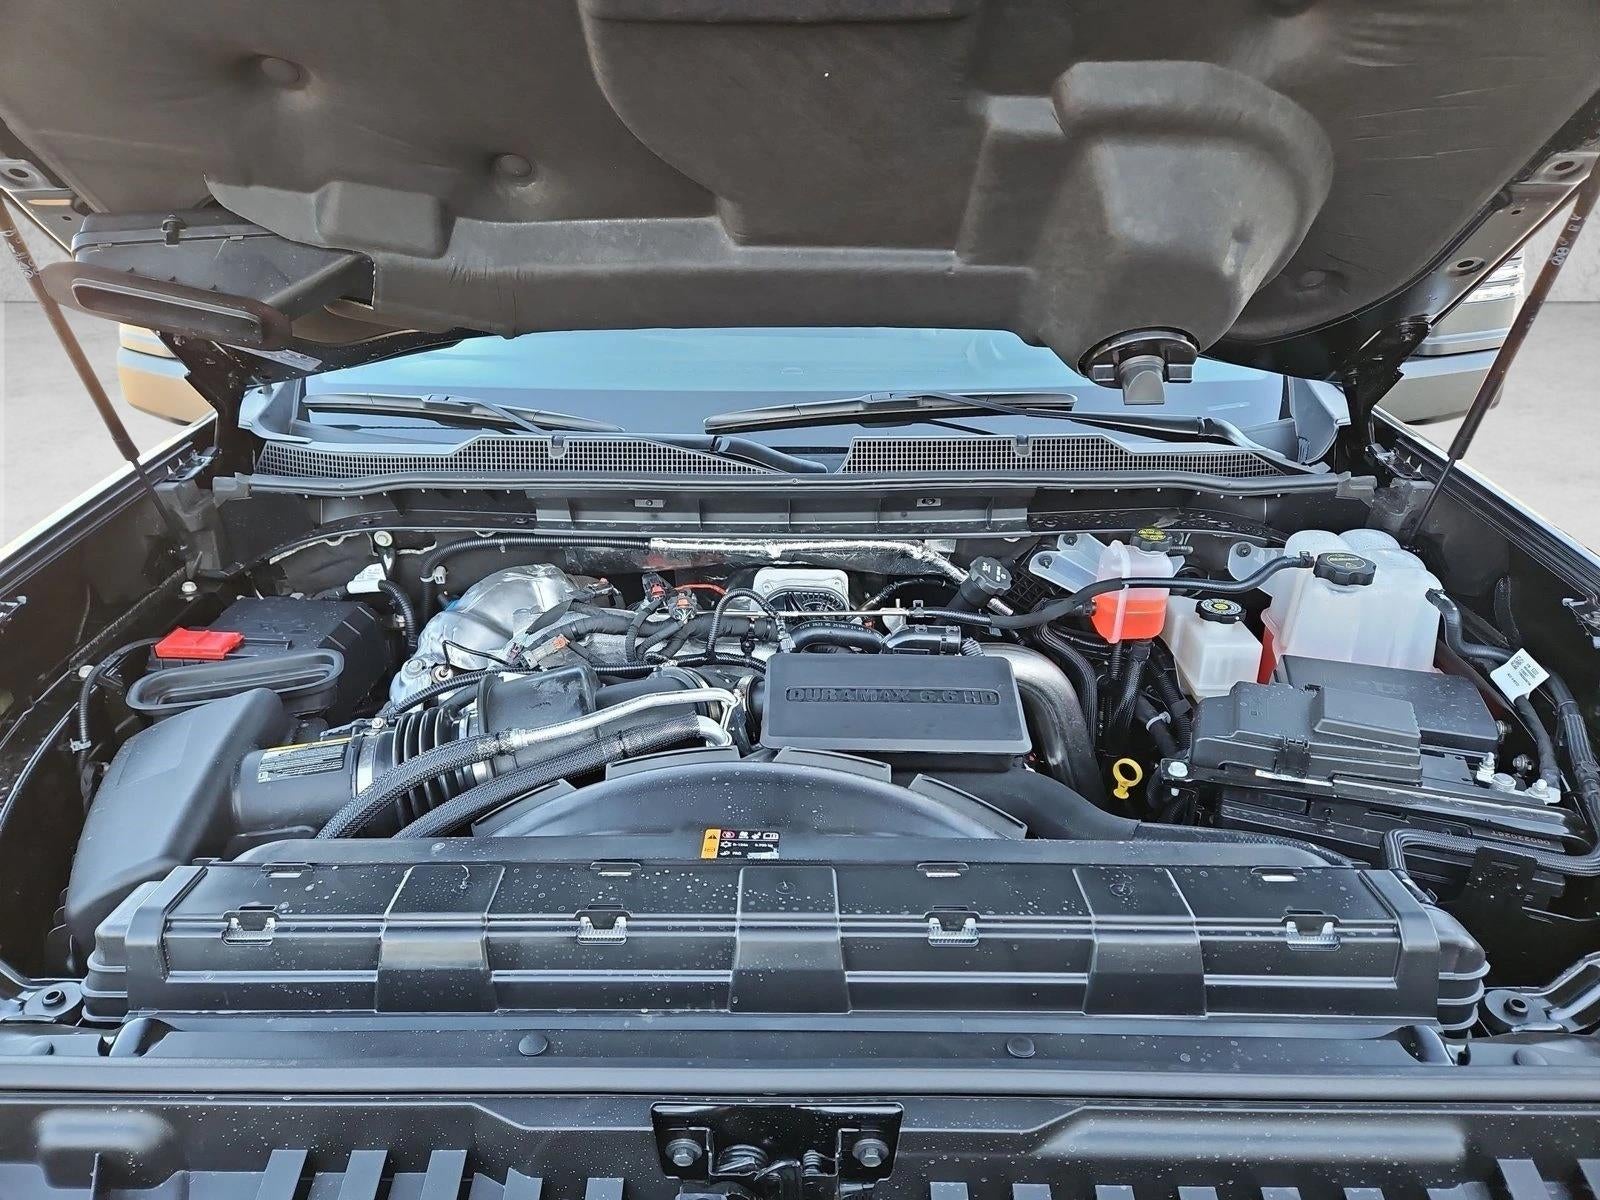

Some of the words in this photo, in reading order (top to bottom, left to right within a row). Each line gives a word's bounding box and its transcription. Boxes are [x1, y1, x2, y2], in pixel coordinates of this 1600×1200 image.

[788, 687, 912, 701] DURAMAX
[919, 690, 957, 703] 6.6
[963, 690, 998, 704] HD
